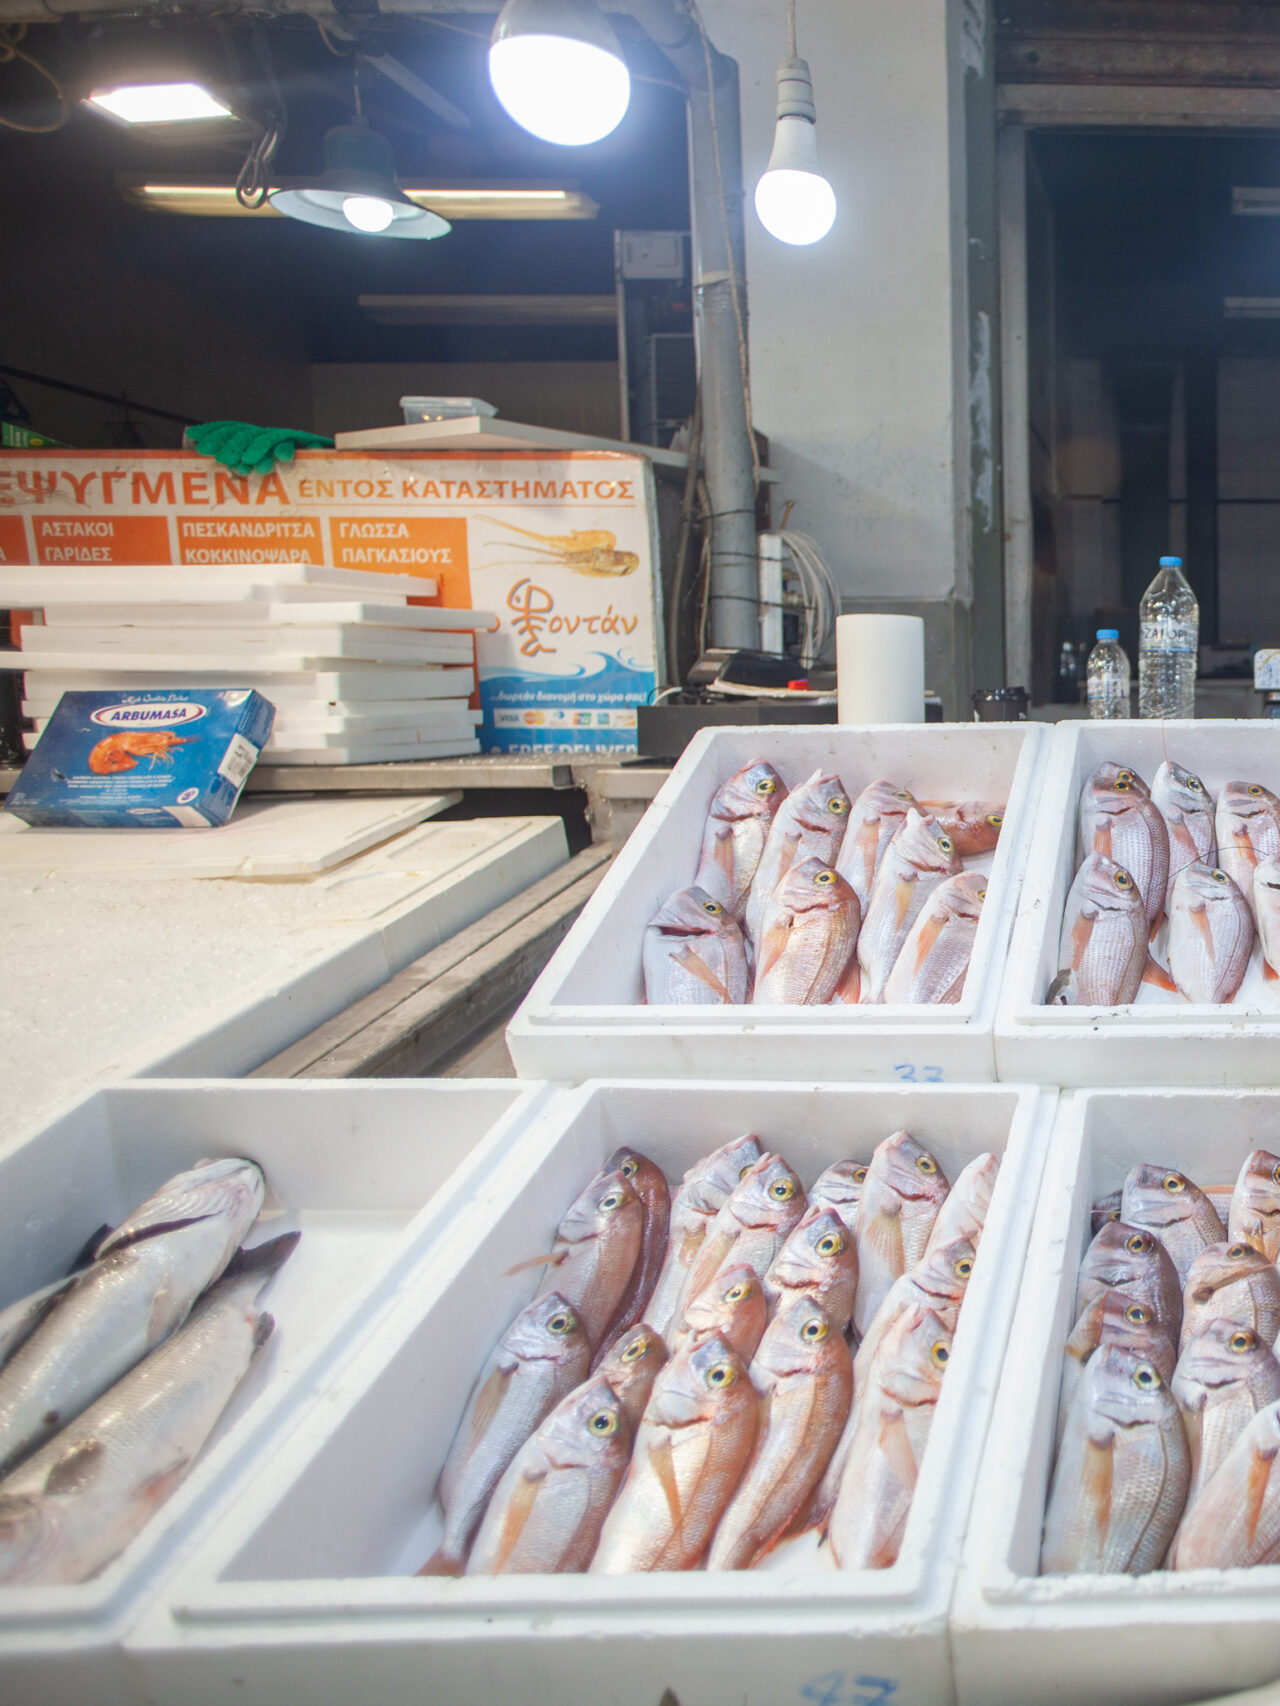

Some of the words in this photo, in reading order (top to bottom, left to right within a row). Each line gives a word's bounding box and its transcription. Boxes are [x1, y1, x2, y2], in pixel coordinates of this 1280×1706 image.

[299, 479, 394, 500] ΕΝΤΟΣ
[402, 479, 636, 500] ΚΑΤΑΣΤΗΜΑΤΟΣ
[42, 521, 114, 538] ΑΣΤΑΚΟΙ
[183, 521, 316, 538] ΠΕΣΚΑΝΔΡΙΤΣΑ
[339, 522, 410, 539] ΓΛΩΣΣΑ
[45, 546, 113, 562] ΓΑΡΙΔΕΣ
[185, 548, 312, 564] ΚΟΚΚΙΝΟΨΑΡΑ
[342, 548, 453, 564] ΠΑΓΚΑΣΙΟΥΣ
[578, 692, 596, 701] στο
[111, 708, 187, 721] ARBUMASA
[500, 712, 519, 722] VISA
